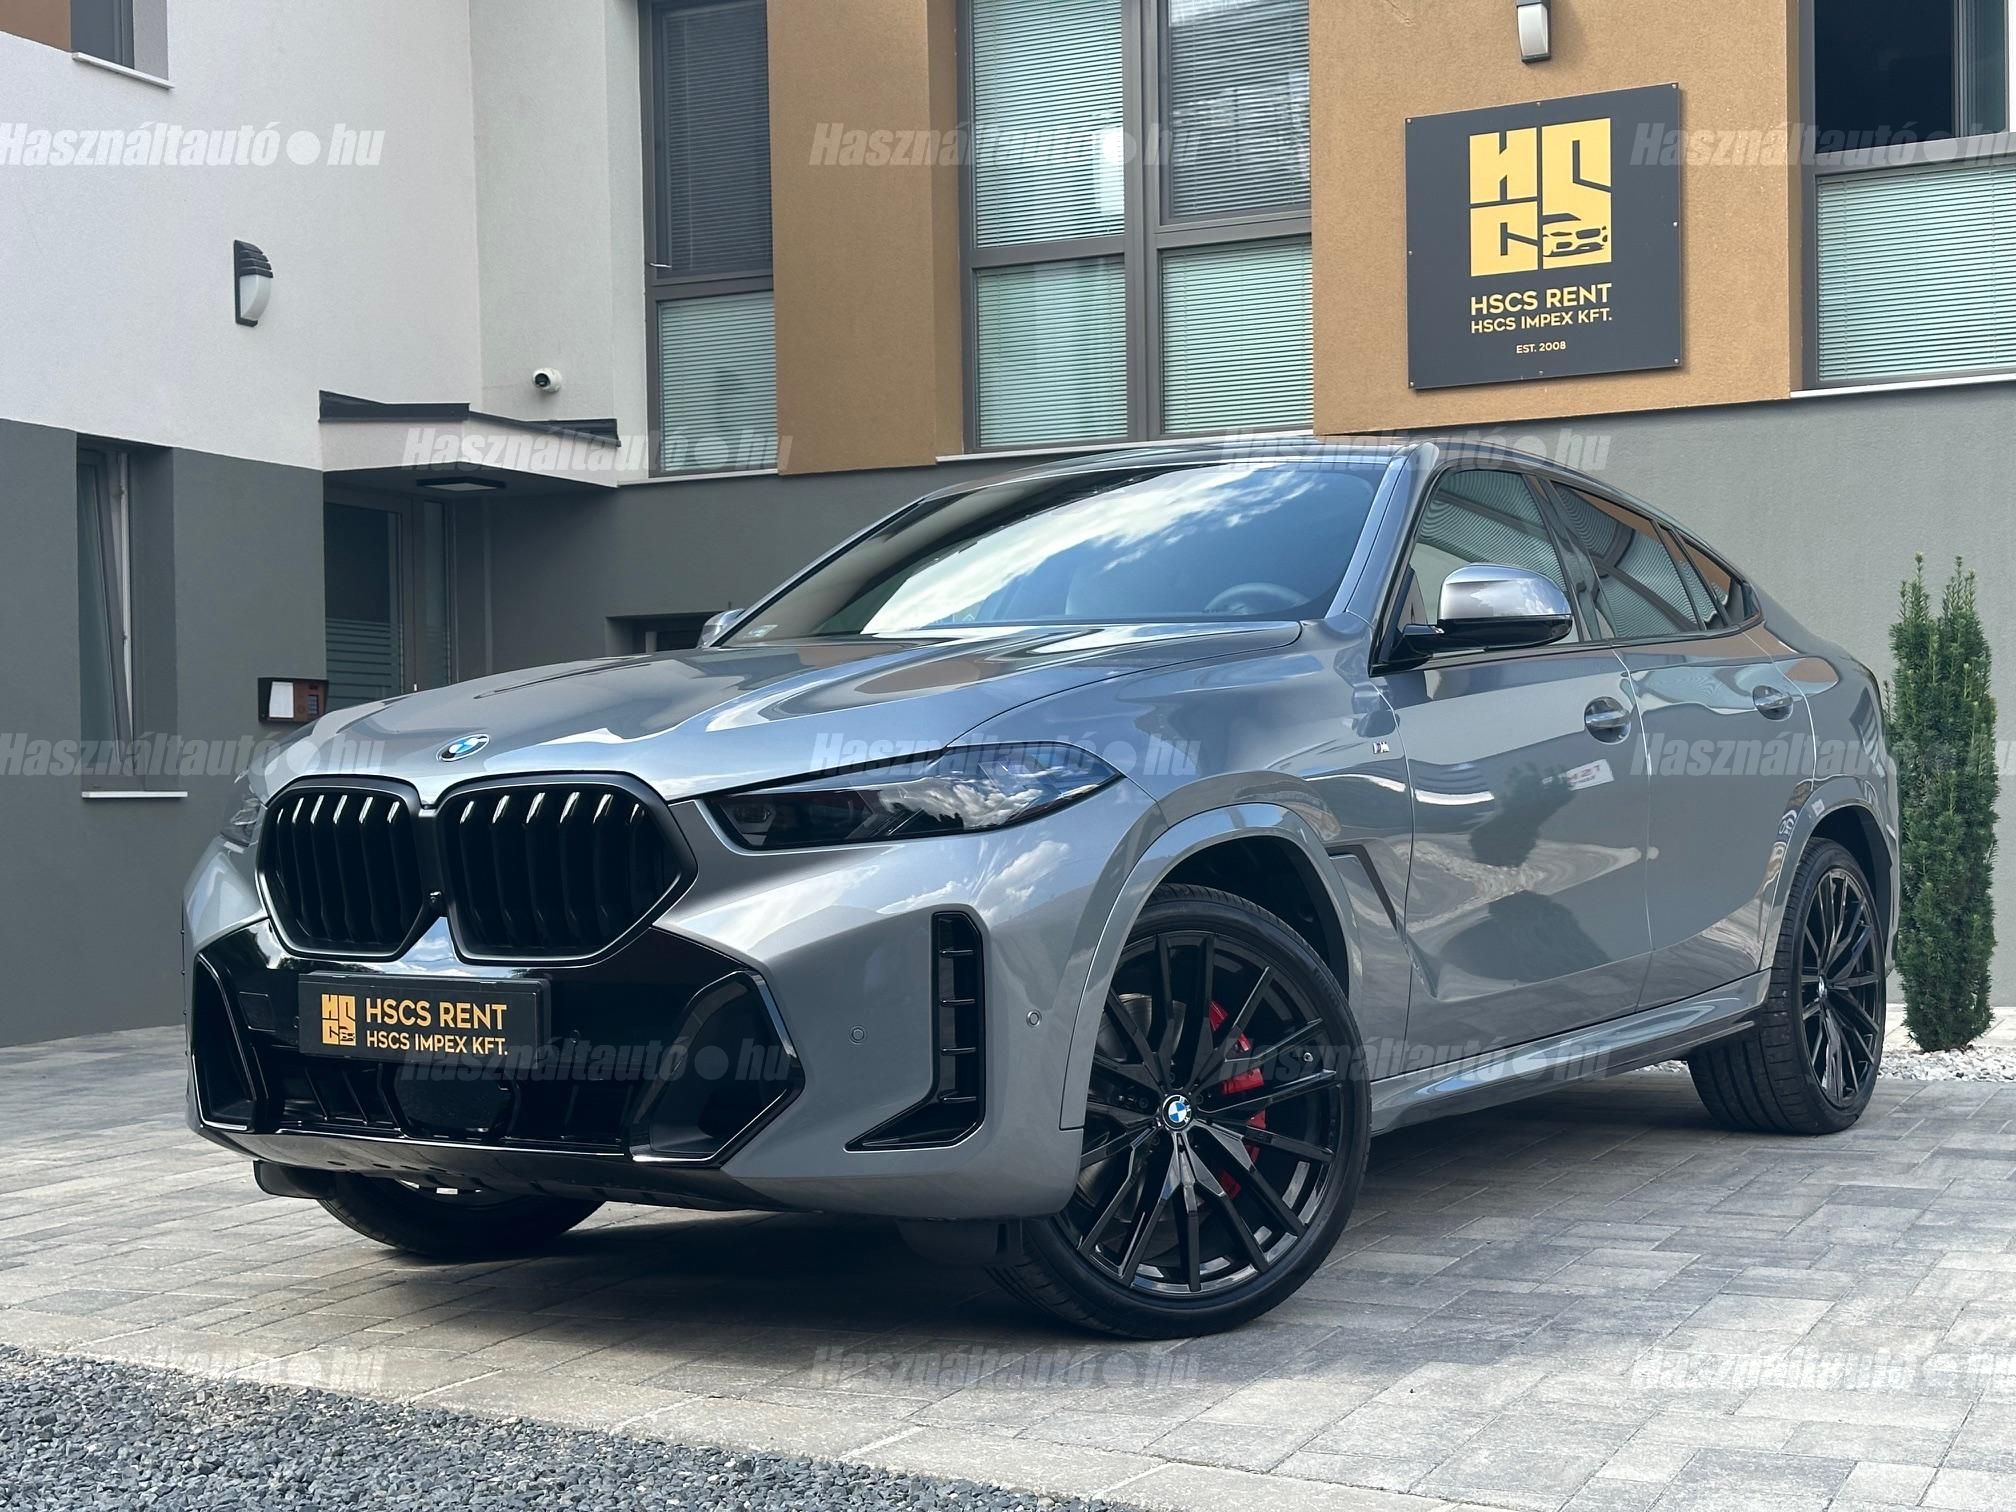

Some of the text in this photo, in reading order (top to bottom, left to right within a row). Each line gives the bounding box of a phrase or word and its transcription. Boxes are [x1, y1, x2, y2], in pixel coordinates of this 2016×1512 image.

[1471, 283, 1612, 315] HSCS RENT
[1471, 307, 1613, 333] HSCS IMPEX KFT.
[1516, 341, 1566, 353] EST. 2008
[365, 997, 508, 1030] HSCS RENT
[366, 1030, 508, 1055] HSCS IMPEX KFT.
